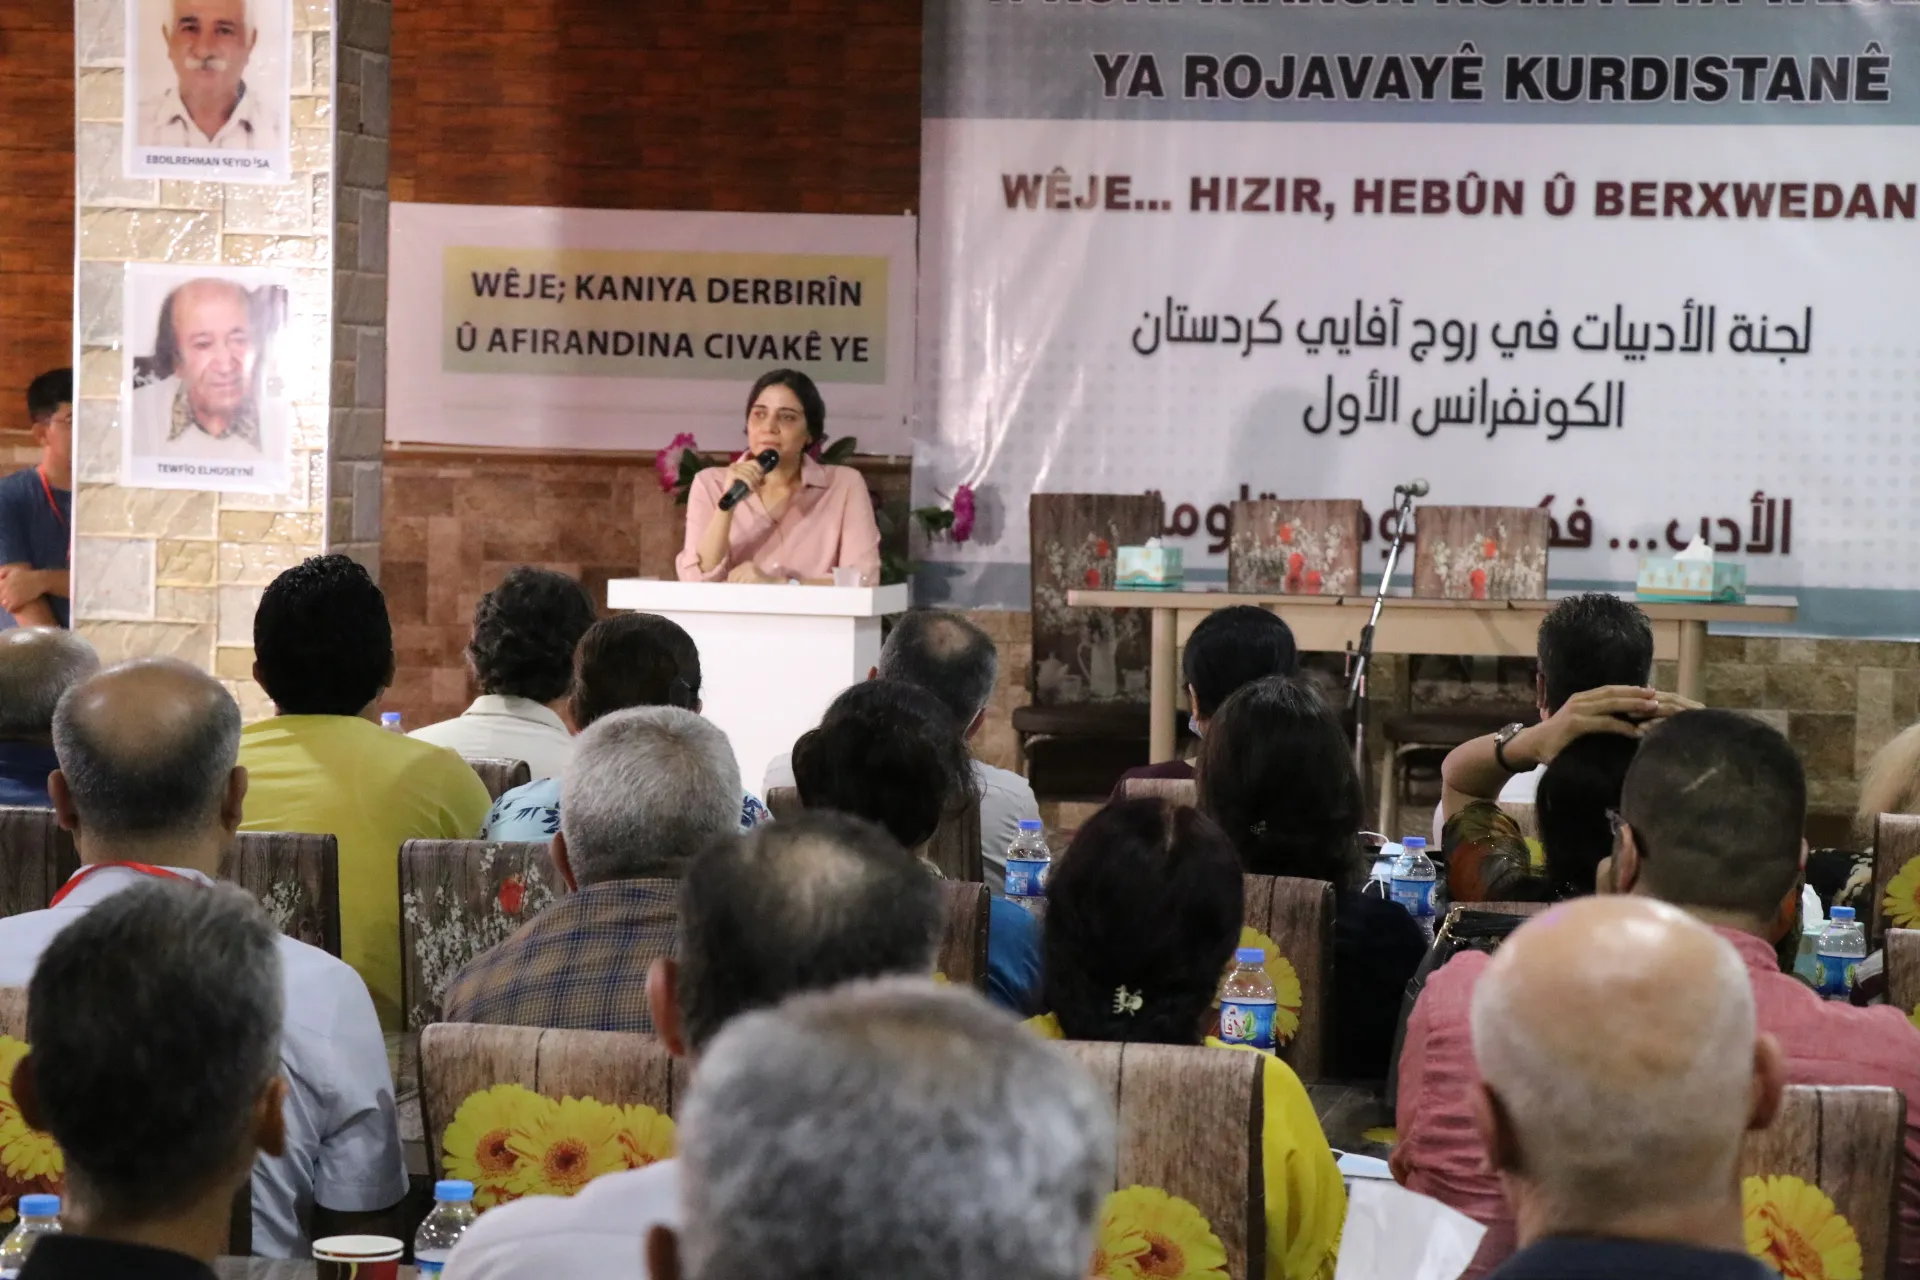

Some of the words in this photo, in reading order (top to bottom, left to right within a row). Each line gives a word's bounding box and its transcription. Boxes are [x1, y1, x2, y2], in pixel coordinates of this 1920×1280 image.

[1093, 53, 1165, 98] YA
[1184, 41, 1484, 101] ROJAVAYÊ
[1504, 41, 1891, 102] KURDISTANÊ
[1189, 175, 1336, 222] HIZIR,
[1353, 171, 1524, 217] HEBÛN
[1544, 171, 1576, 217] Û
[1594, 180, 1917, 220] BERXWEDAN
[471, 267, 567, 304] WÊJE;
[575, 273, 698, 304] KANIYA
[707, 275, 863, 308] DERBIRÎN
[456, 321, 478, 353] Û
[487, 328, 695, 359] AFIRANDINA
[704, 330, 823, 362] CIVAKÊ
[830, 336, 869, 363] YE
[1132, 295, 1283, 358] كردستان
[1410, 318, 1478, 363] روج
[1491, 308, 1560, 359] في
[1572, 297, 1717, 361] الأدبيات
[1728, 306, 1813, 364] لجنة
[1302, 369, 1400, 437] الأول
[1411, 377, 1626, 441] الكونفرانس
